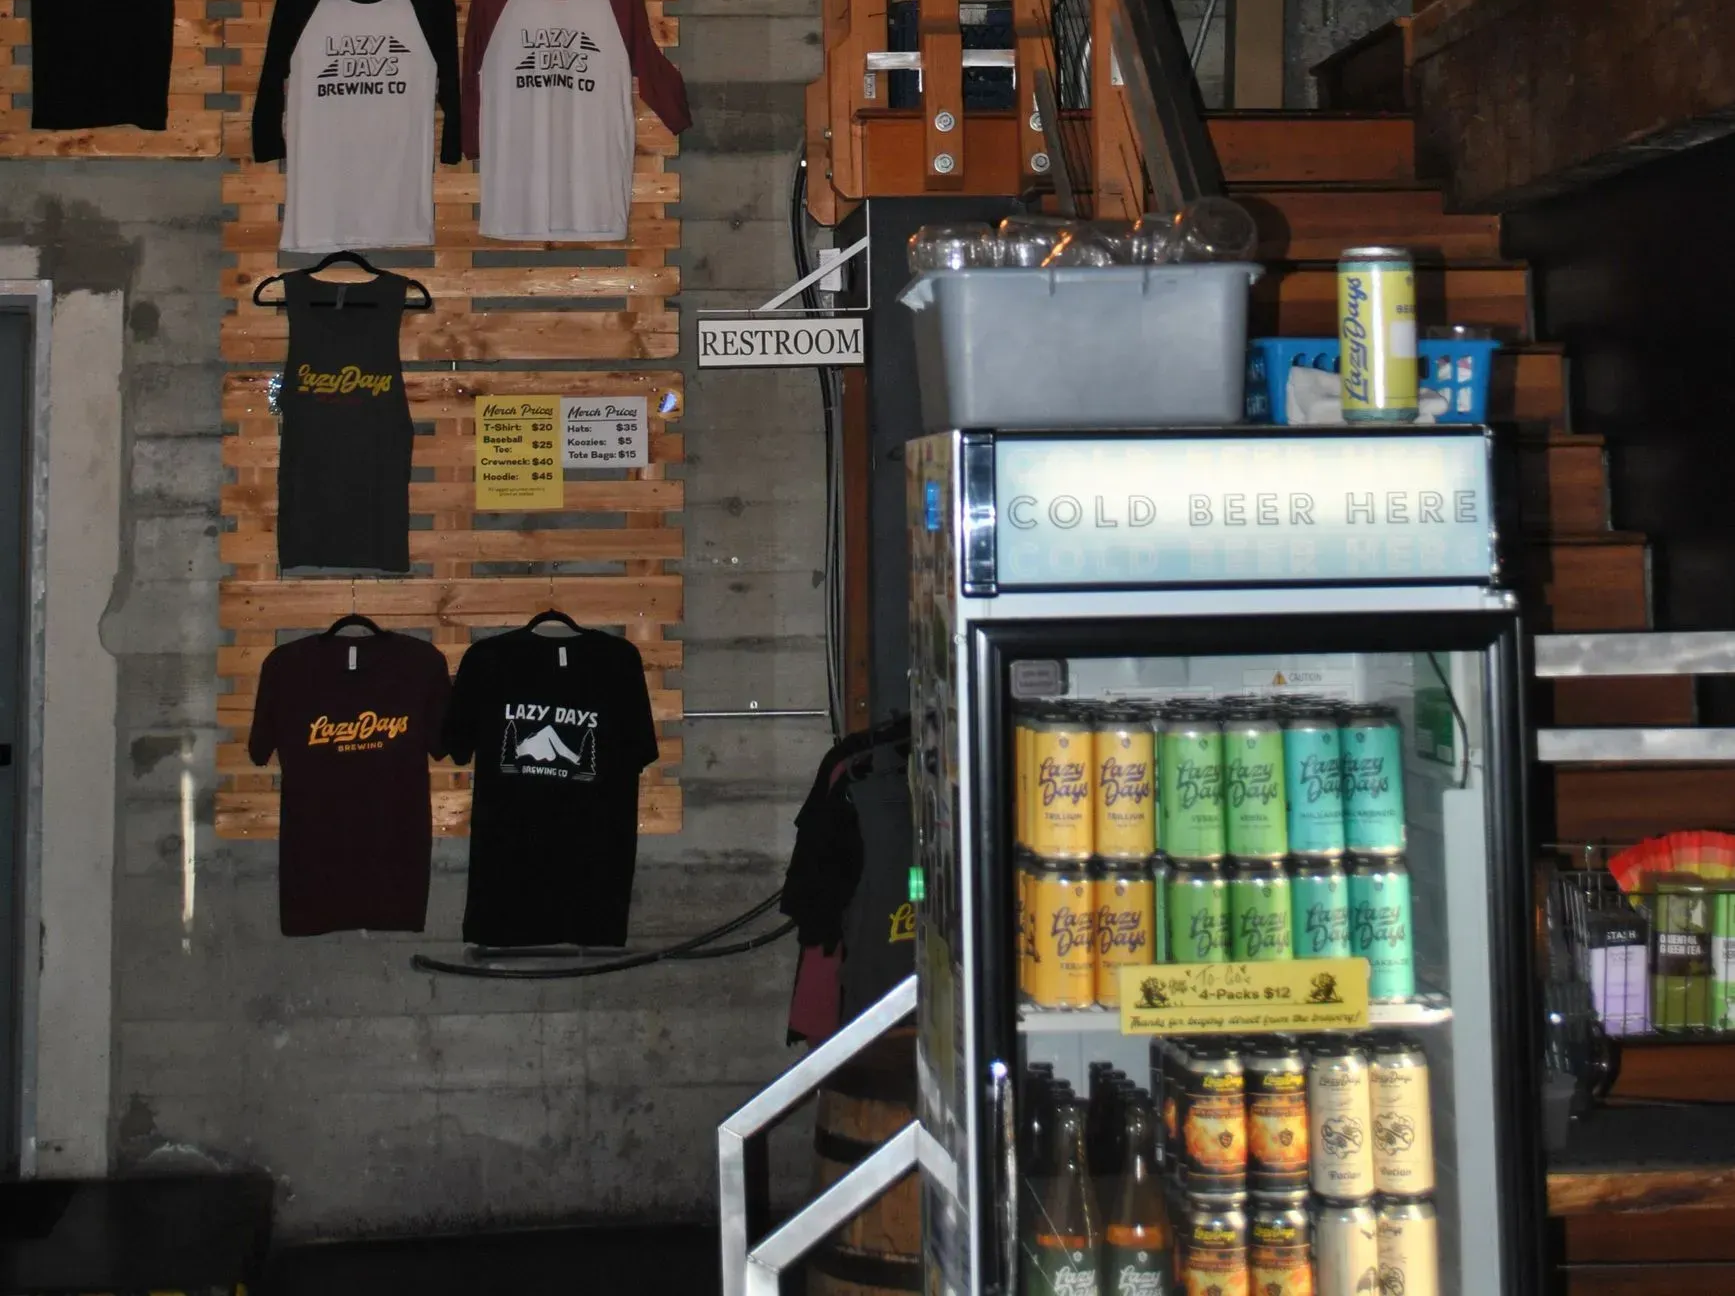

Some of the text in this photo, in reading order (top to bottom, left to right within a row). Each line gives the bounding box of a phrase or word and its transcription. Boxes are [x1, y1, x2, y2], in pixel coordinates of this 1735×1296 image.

[325, 35, 386, 56] LAZY
[521, 28, 578, 48] LAZY
[342, 56, 399, 77] DAYS
[538, 51, 589, 72] DAYS
[317, 81, 407, 97] BREWING CO
[516, 75, 595, 92] BREWING CO
[701, 329, 861, 356] RESTROOM
[483, 404, 553, 416] Merch Prices
[568, 405, 637, 418] Merch Prices
[532, 423, 553, 432] $20
[567, 423, 637, 433] Hats: $35
[483, 436, 522, 444] Baseball
[532, 440, 553, 449] $25
[567, 437, 632, 446] Koozies: $5
[481, 457, 553, 466] Crewneck: $40
[569, 450, 636, 461] Tote Bags: $15
[483, 472, 553, 481] Hoodie: $45
[1007, 490, 1478, 529] COLD BEER HERE
[1289, 672, 1322, 682] CAUTION
[504, 704, 599, 728] LAZY DAYS
[337, 741, 384, 753] BREWING
[1039, 756, 1086, 785] Lazy
[1100, 756, 1147, 785] Lazy
[1225, 757, 1274, 788] Lazy
[1043, 781, 1088, 807] Days
[1105, 782, 1149, 807] Days
[1230, 780, 1278, 808] Days
[1241, 907, 1287, 938] Lazy
[1354, 900, 1400, 931] Lazy
[1100, 926, 1146, 955] Days
[1360, 923, 1405, 950] Days
[1199, 986, 1292, 1001] 4-Packs $12
[1130, 1016, 1165, 1028] Thanks
[1168, 1017, 1184, 1029] for
[1187, 1016, 1224, 1028] buying
[1228, 1014, 1260, 1025] direct
[1263, 1015, 1289, 1026] from
[1292, 1014, 1308, 1023] the
[1055, 1266, 1096, 1291] Lazy
[1118, 1264, 1161, 1290] Lazy
